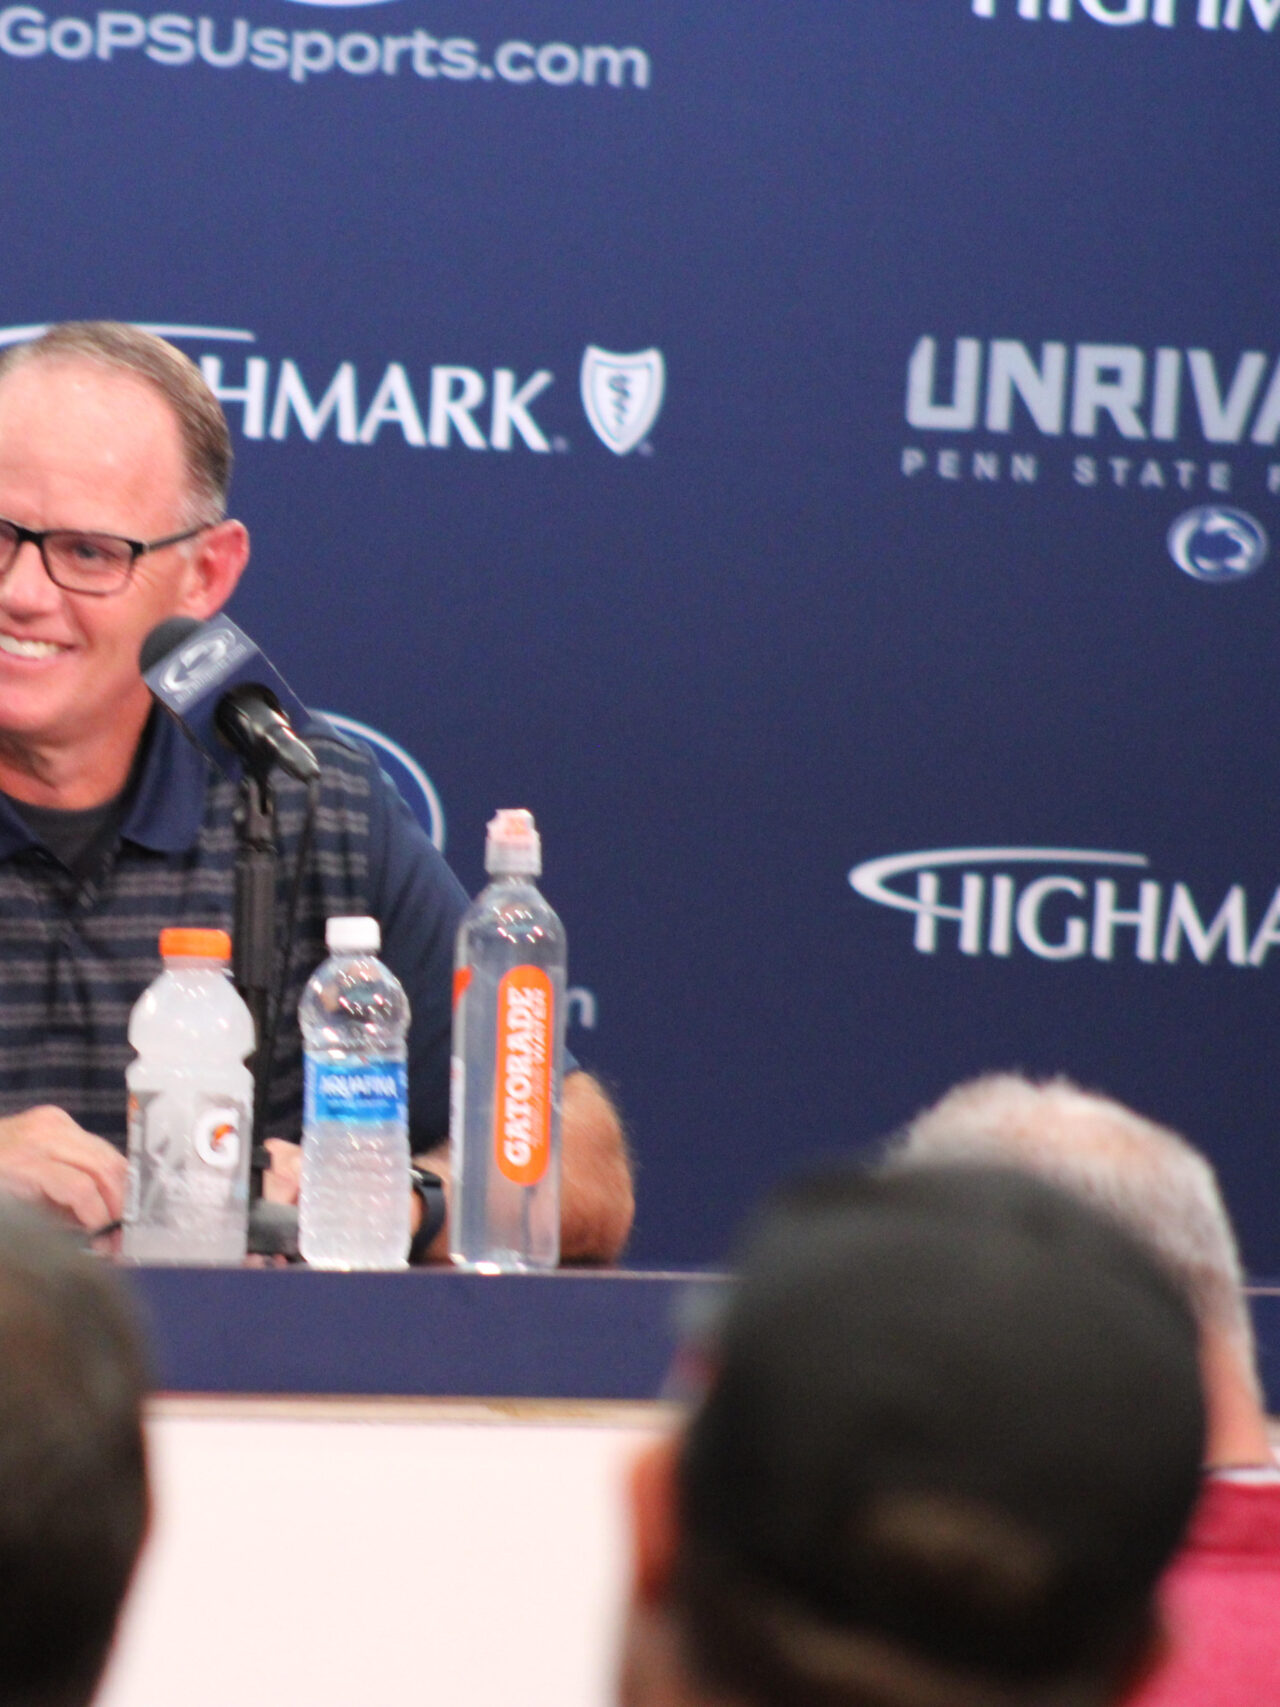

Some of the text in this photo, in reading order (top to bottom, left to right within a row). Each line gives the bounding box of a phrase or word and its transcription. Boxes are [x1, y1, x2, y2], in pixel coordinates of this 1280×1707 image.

[199, 354, 553, 454] HMARK
[905, 334, 1280, 445] UNRIV
[900, 446, 1037, 484] PENN
[1072, 454, 1232, 493] STATE
[503, 985, 535, 1167] GATORADE
[194, 1107, 240, 1169] G
